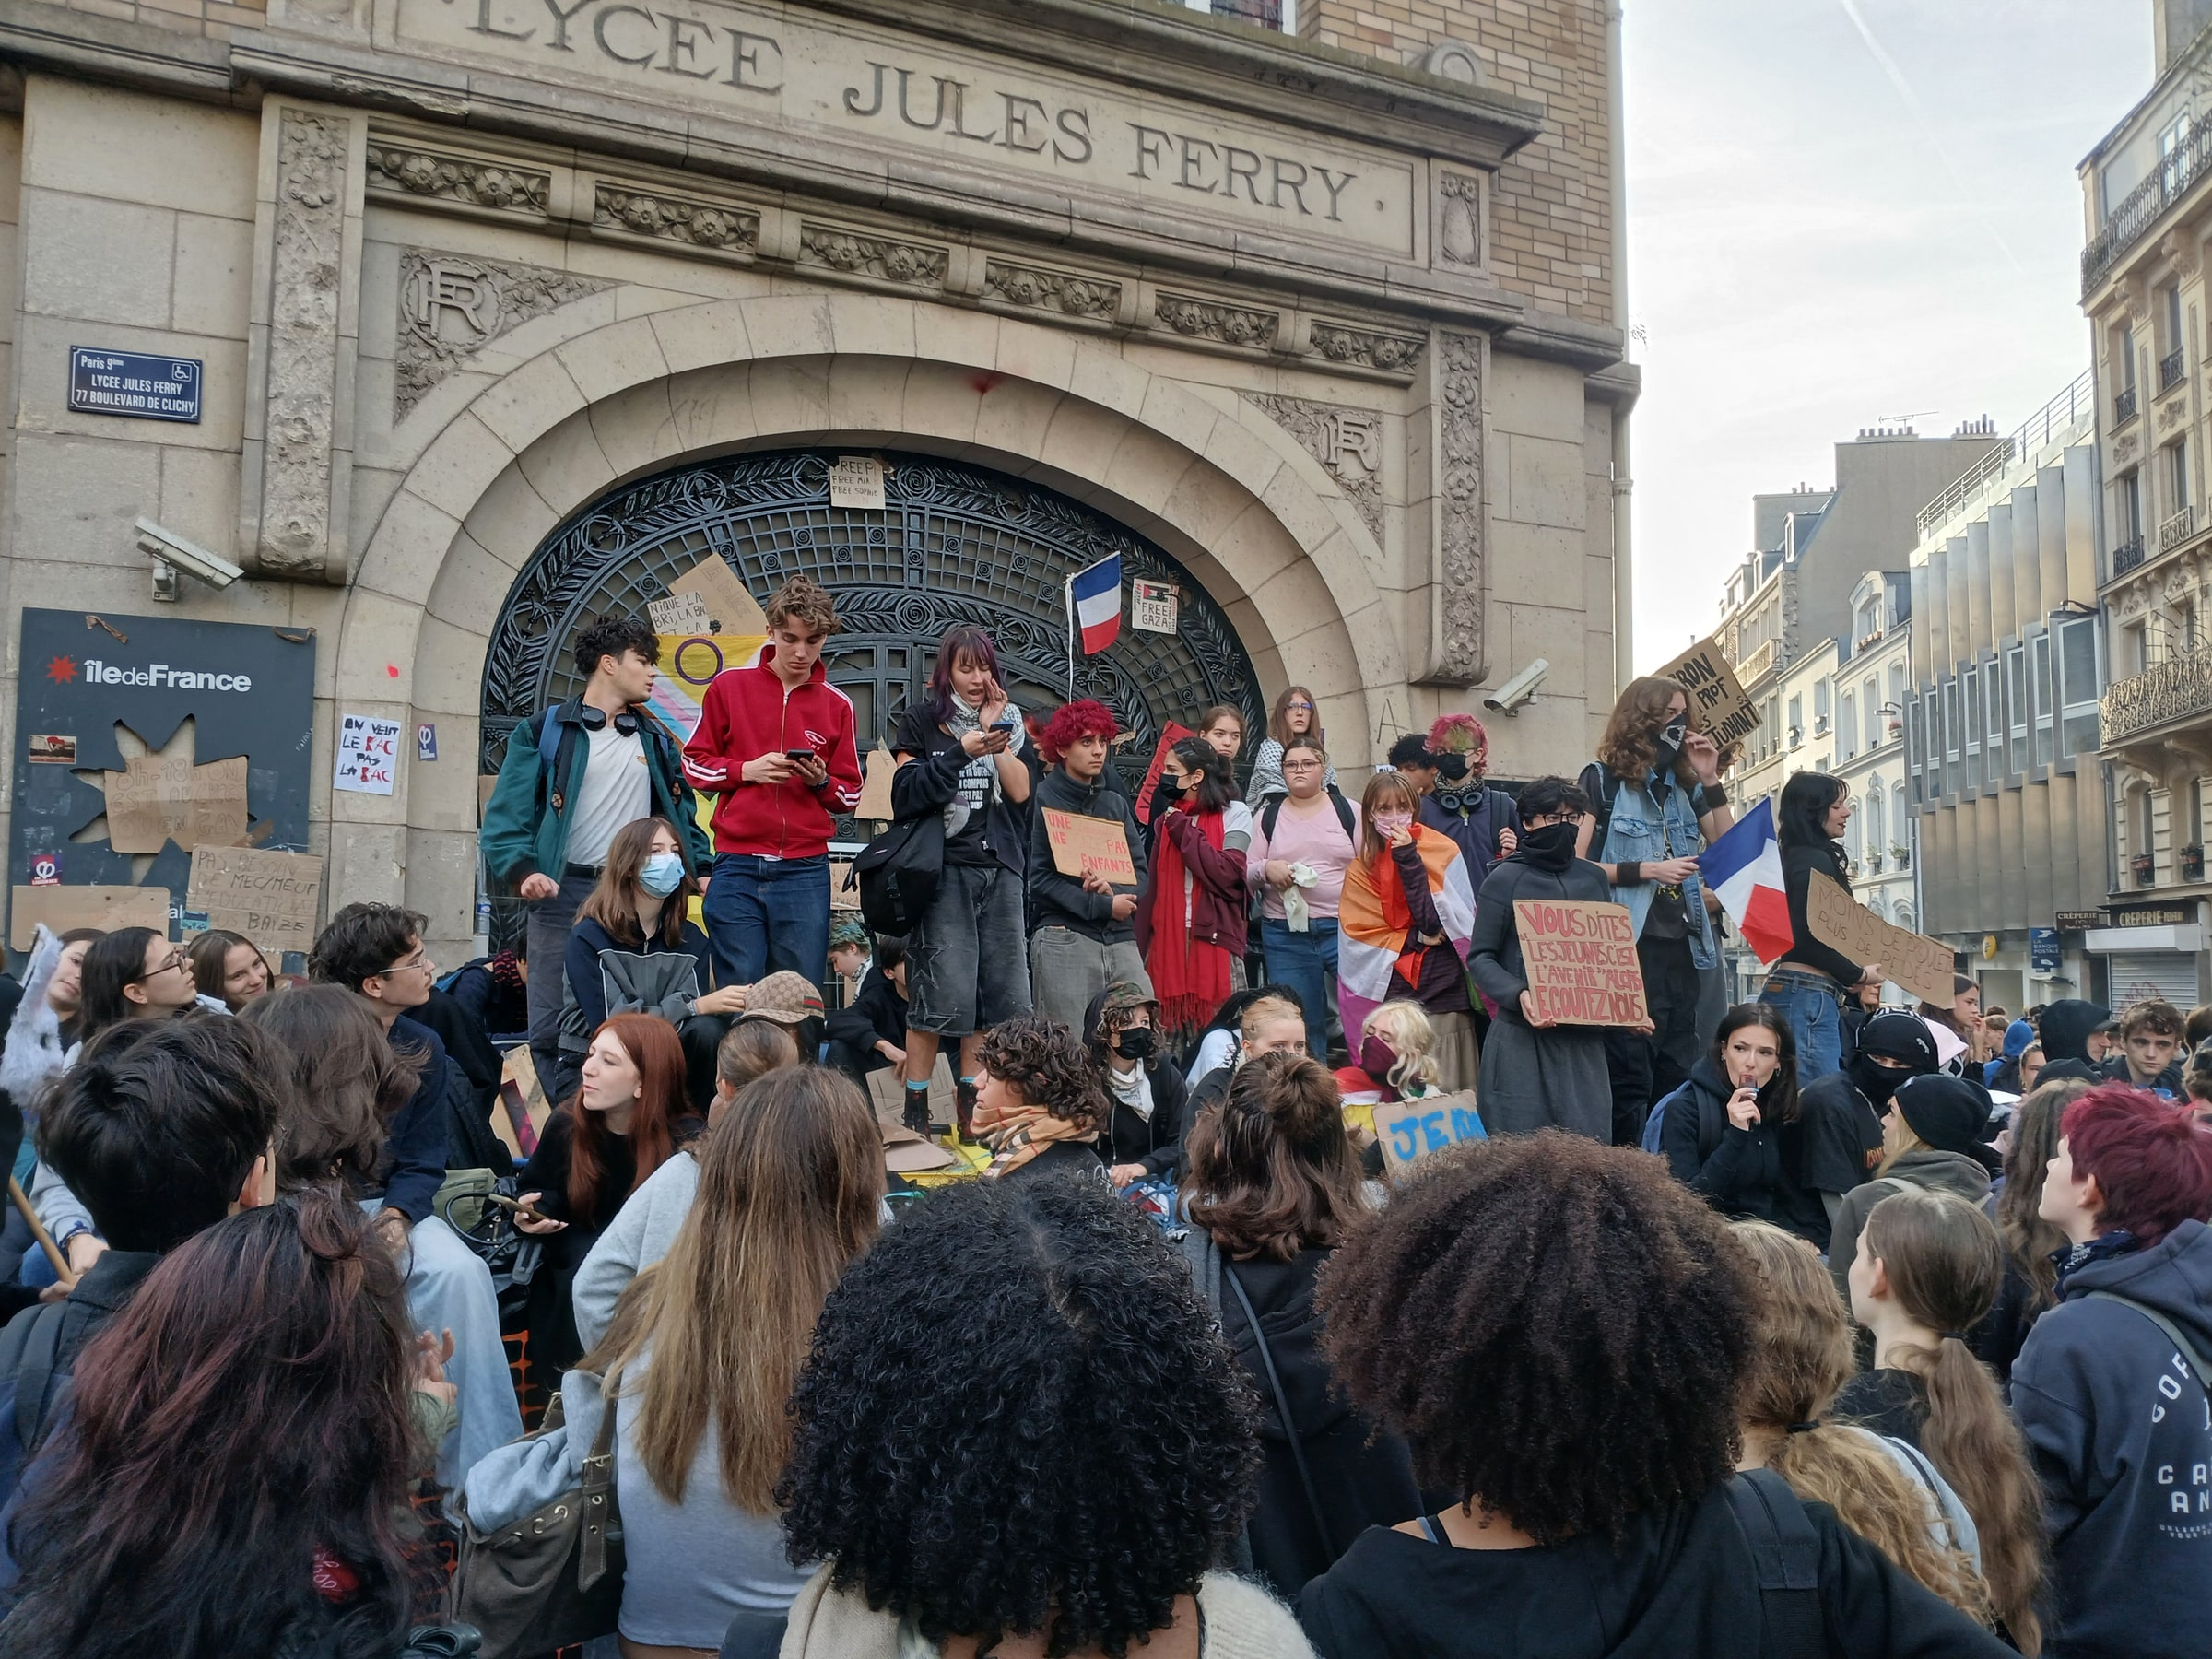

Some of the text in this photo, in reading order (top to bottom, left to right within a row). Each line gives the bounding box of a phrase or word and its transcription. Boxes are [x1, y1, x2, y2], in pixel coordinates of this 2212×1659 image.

[465, 0, 1359, 223] LYCEE JULES FERRY
[80, 354, 104, 369] Paris
[91, 374, 182, 395] LYCEE JULES FERRY
[76, 389, 194, 413] 77 BOULEVARD DE CLICHY
[833, 461, 864, 474] REE
[831, 475, 854, 485] FREE
[831, 485, 853, 495] FREE
[686, 591, 704, 606] LA
[677, 607, 693, 621] LA
[1142, 602, 1169, 617] FREE
[686, 622, 703, 635] LA
[1141, 614, 1168, 628] GAZA
[1696, 677, 1729, 710] PROF
[342, 733, 394, 755] LE BAC
[356, 752, 381, 766] PAS
[207, 760, 241, 782] ON
[339, 763, 391, 782] LA BAC
[158, 815, 189, 834] EN
[1047, 813, 1072, 830] UNE
[1053, 831, 1127, 854] NE PAS
[197, 850, 228, 872] PAS
[1081, 853, 1133, 874] ENFANTS
[230, 874, 318, 896] MEC/MEUF
[1518, 903, 1586, 938] VOUS
[1818, 886, 1874, 936] MOINS
[1880, 923, 1900, 952] DE
[1818, 910, 1848, 941] PLUS
[1854, 938, 1873, 956] DE
[1558, 940, 1608, 966] JEUNES
[1606, 969, 1643, 993] ALORS
[1535, 985, 1644, 1023] ECOUTEZ NOUS
